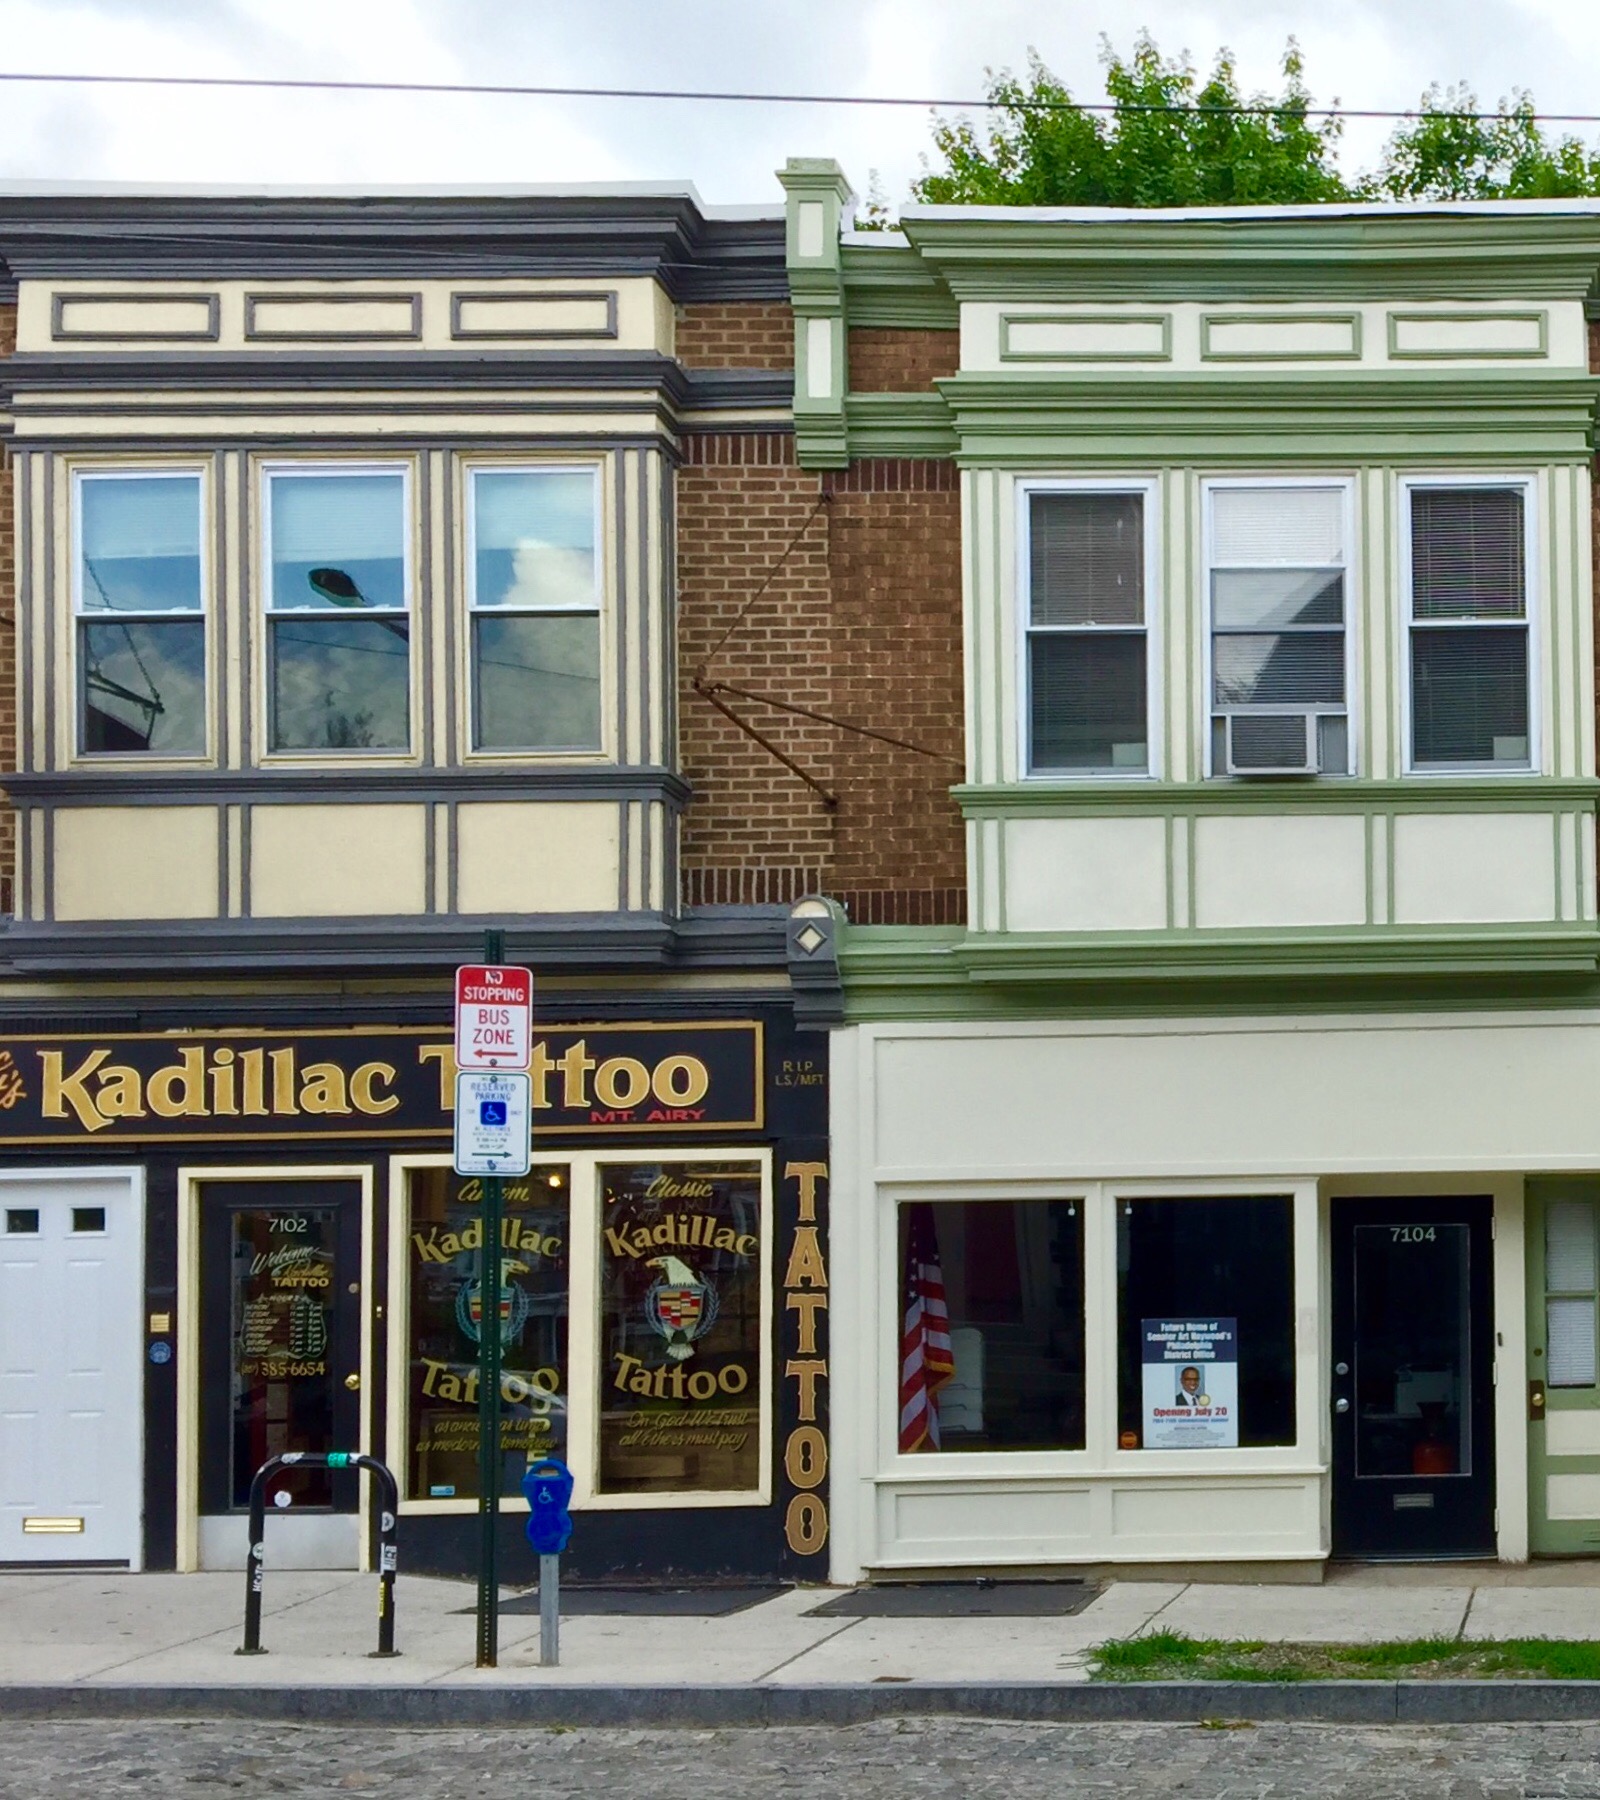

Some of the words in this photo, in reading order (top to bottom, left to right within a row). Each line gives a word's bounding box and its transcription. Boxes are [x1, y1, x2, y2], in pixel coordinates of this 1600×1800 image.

[484, 970, 504, 985] NO
[464, 986, 525, 1002] STOPPING
[478, 1008, 510, 1026] BUS
[472, 1028, 515, 1045] ZONE
[36, 1046, 400, 1132] Kadillac
[418, 1039, 709, 1110] Tttoo
[470, 1082, 516, 1092] RESERVED
[475, 1091, 511, 1102] PARKING
[591, 1110, 637, 1123] MT.
[647, 1109, 706, 1122] AIRY
[457, 1179, 530, 1201] Cuom
[645, 1174, 714, 1198] Classic
[269, 1218, 308, 1233] 7102
[411, 1217, 562, 1264] Kadllac
[603, 1213, 758, 1259] Kadillac
[1390, 1226, 1437, 1242] 7104
[272, 1278, 330, 1288] TATTOO
[1161, 1322, 1184, 1332] Future
[1209, 1322, 1218, 1331] of
[1146, 1332, 1177, 1341] Senator
[1178, 1332, 1190, 1341] Art
[783, 1161, 829, 1556] TATTOO
[1164, 1350, 1192, 1360] District
[1193, 1350, 1216, 1360] Office
[261, 1361, 326, 1377] 385-6654
[613, 1352, 749, 1400] Tattoo
[420, 1357, 560, 1404] Tatoo
[1153, 1407, 1192, 1418] Opening
[1194, 1406, 1212, 1417] July
[1215, 1406, 1228, 1416] 20
[655, 1412, 688, 1431] God
[618, 1430, 641, 1446] all
[685, 1429, 725, 1446] must
[721, 1431, 749, 1453] pay
